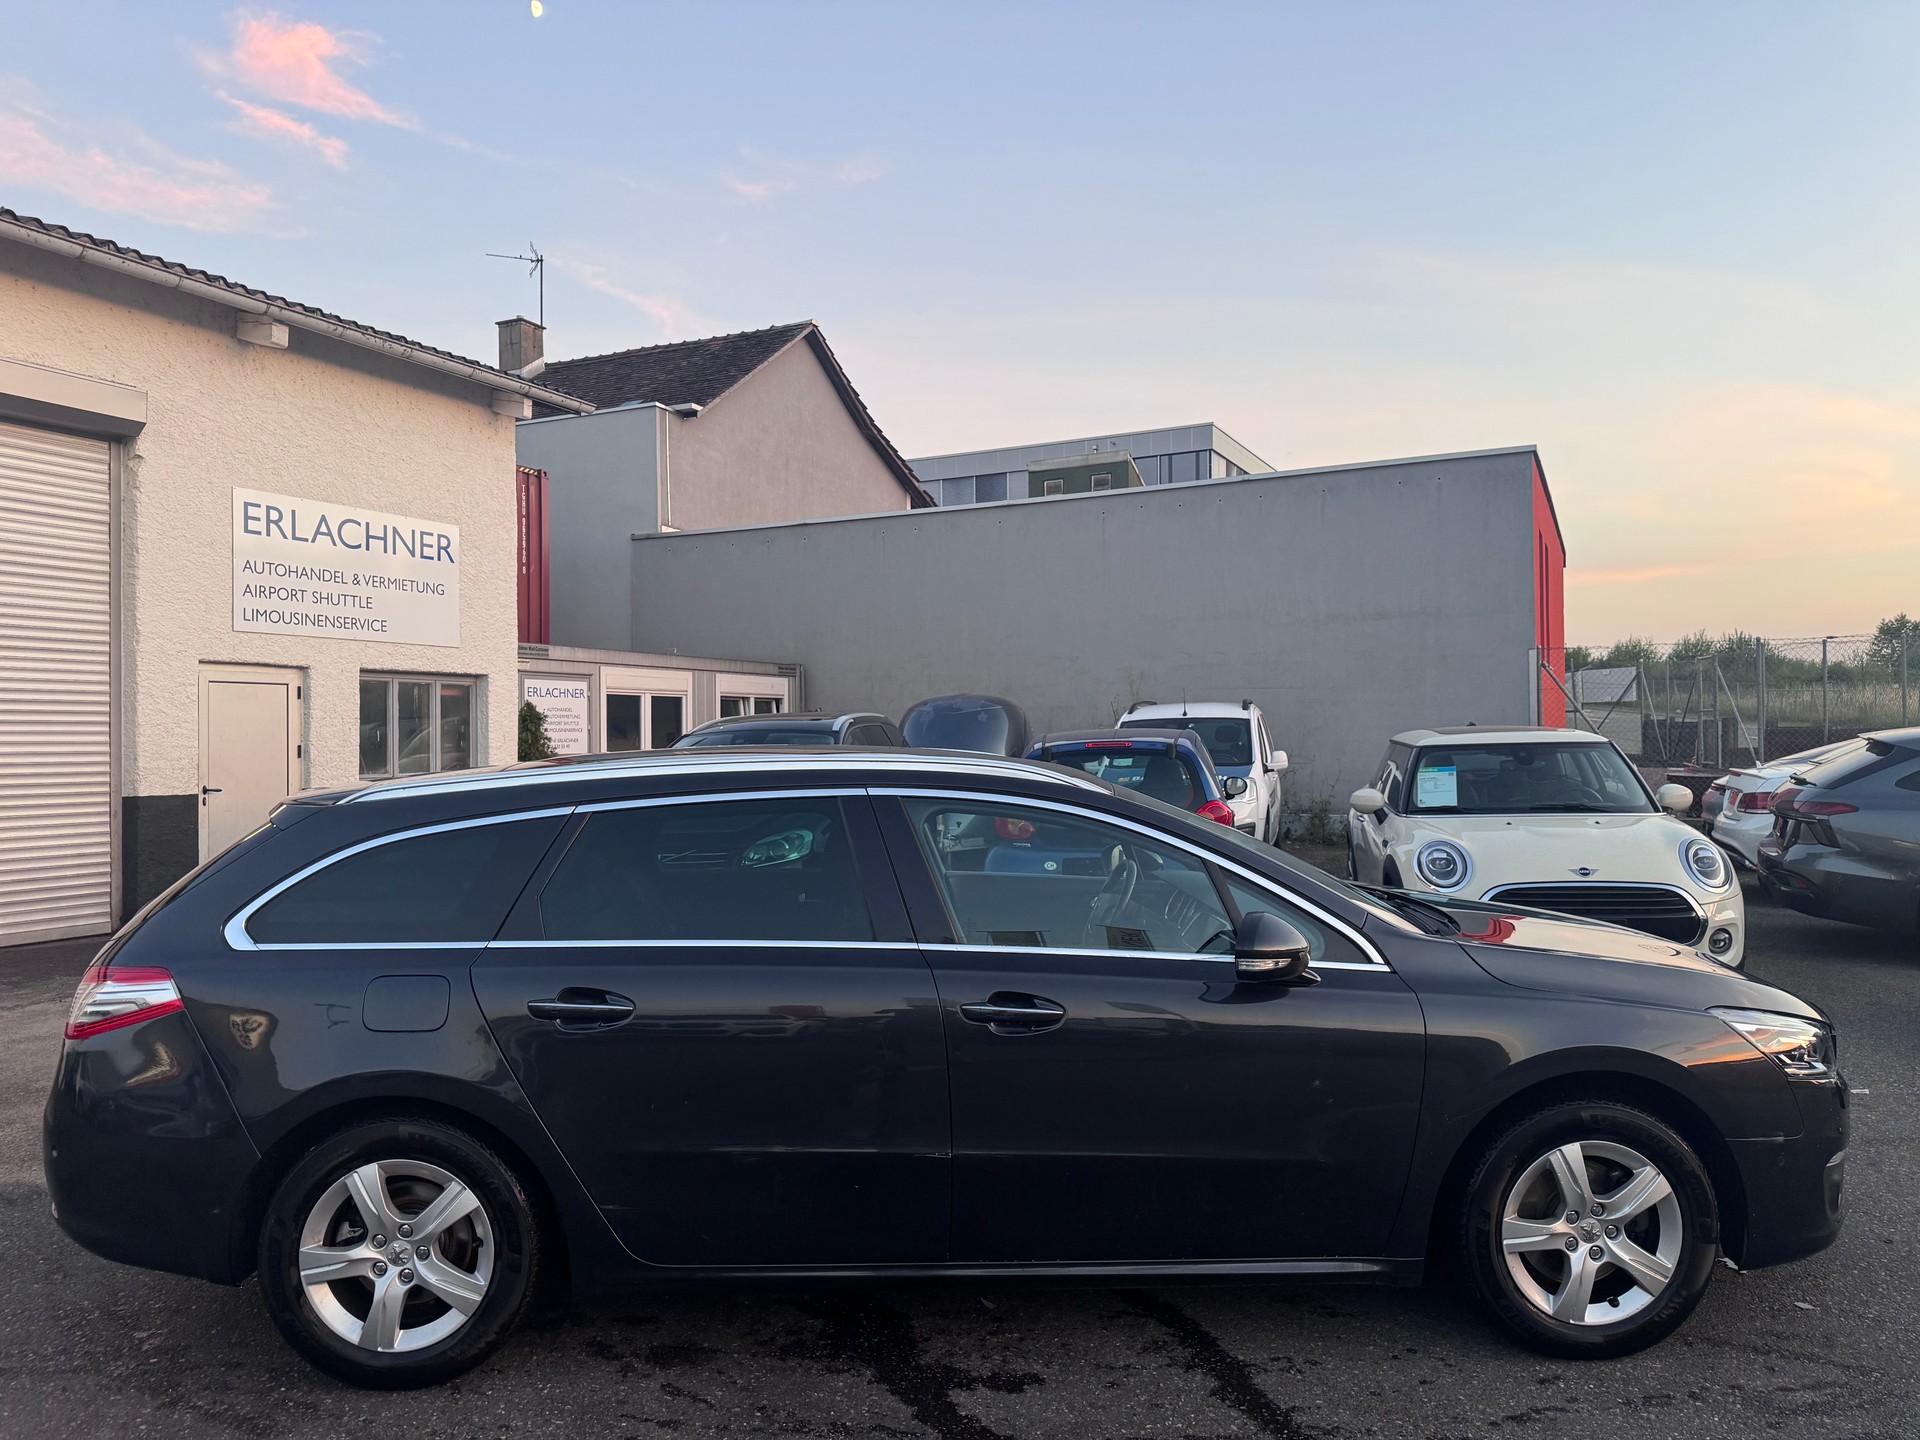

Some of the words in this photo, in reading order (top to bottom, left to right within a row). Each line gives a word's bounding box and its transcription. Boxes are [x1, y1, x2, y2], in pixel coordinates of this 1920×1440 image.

[243, 501, 455, 564] ERLACHNER
[242, 559, 348, 585] AUTOHANDEL
[351, 573, 361, 586] &
[363, 574, 445, 596] VERMIETUNG
[242, 583, 307, 602] AIRPORT
[312, 590, 373, 610] SHUTTLE
[243, 607, 388, 633] LIMOUSINENSERVICE
[527, 686, 585, 699] ERLACHNER
